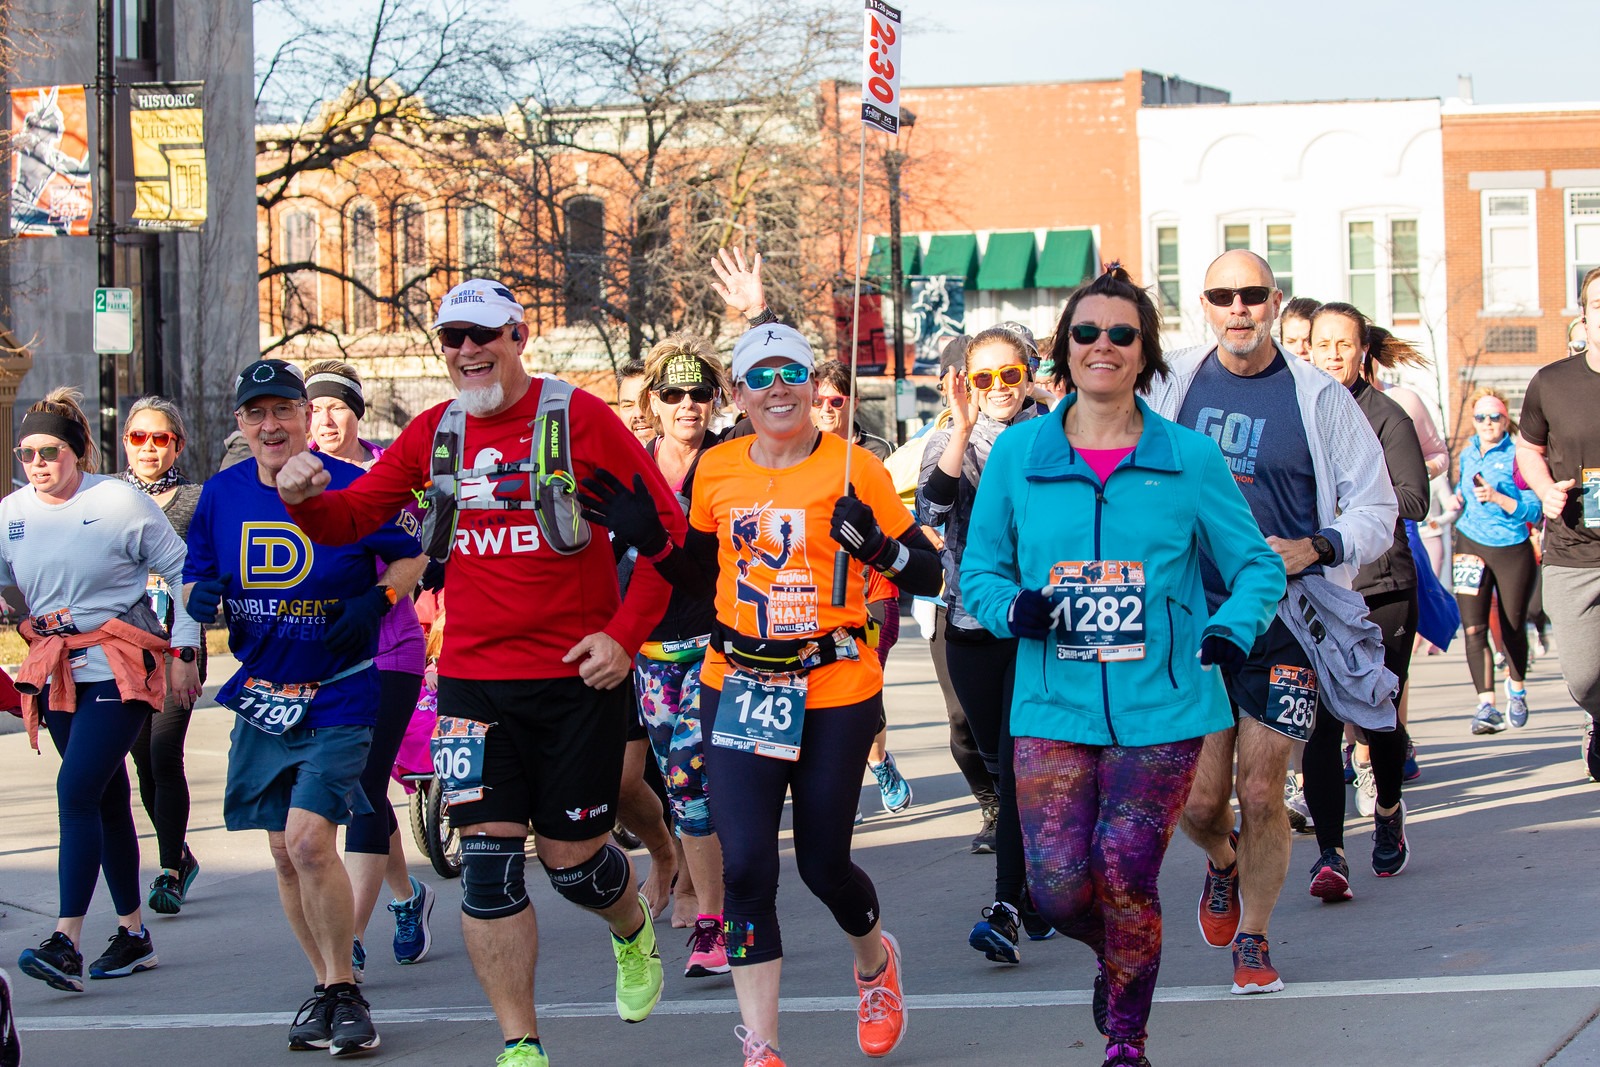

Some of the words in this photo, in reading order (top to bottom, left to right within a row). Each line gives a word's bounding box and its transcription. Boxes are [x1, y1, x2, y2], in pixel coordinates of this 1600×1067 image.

[868, 15, 896, 104] 2:30
[138, 93, 195, 109] HISTORIC
[142, 124, 202, 139] LIBERTY
[97, 293, 106, 310] 2
[107, 303, 130, 311] PARKING
[669, 372, 702, 385] BEER
[1195, 406, 1267, 458] GO!
[1223, 455, 1255, 475] ouis
[470, 516, 507, 528] TEAM
[452, 525, 540, 556] RWB
[771, 590, 816, 602] LIBERTY
[771, 605, 815, 620] HALF
[772, 616, 817, 625] MARATHON
[1053, 595, 1143, 632] 1282
[795, 621, 817, 632] 5K
[239, 696, 304, 727] 1190
[735, 690, 793, 731] 143
[433, 746, 472, 780] 606
[589, 803, 609, 819] RWB
[466, 842, 501, 852] cambivo
